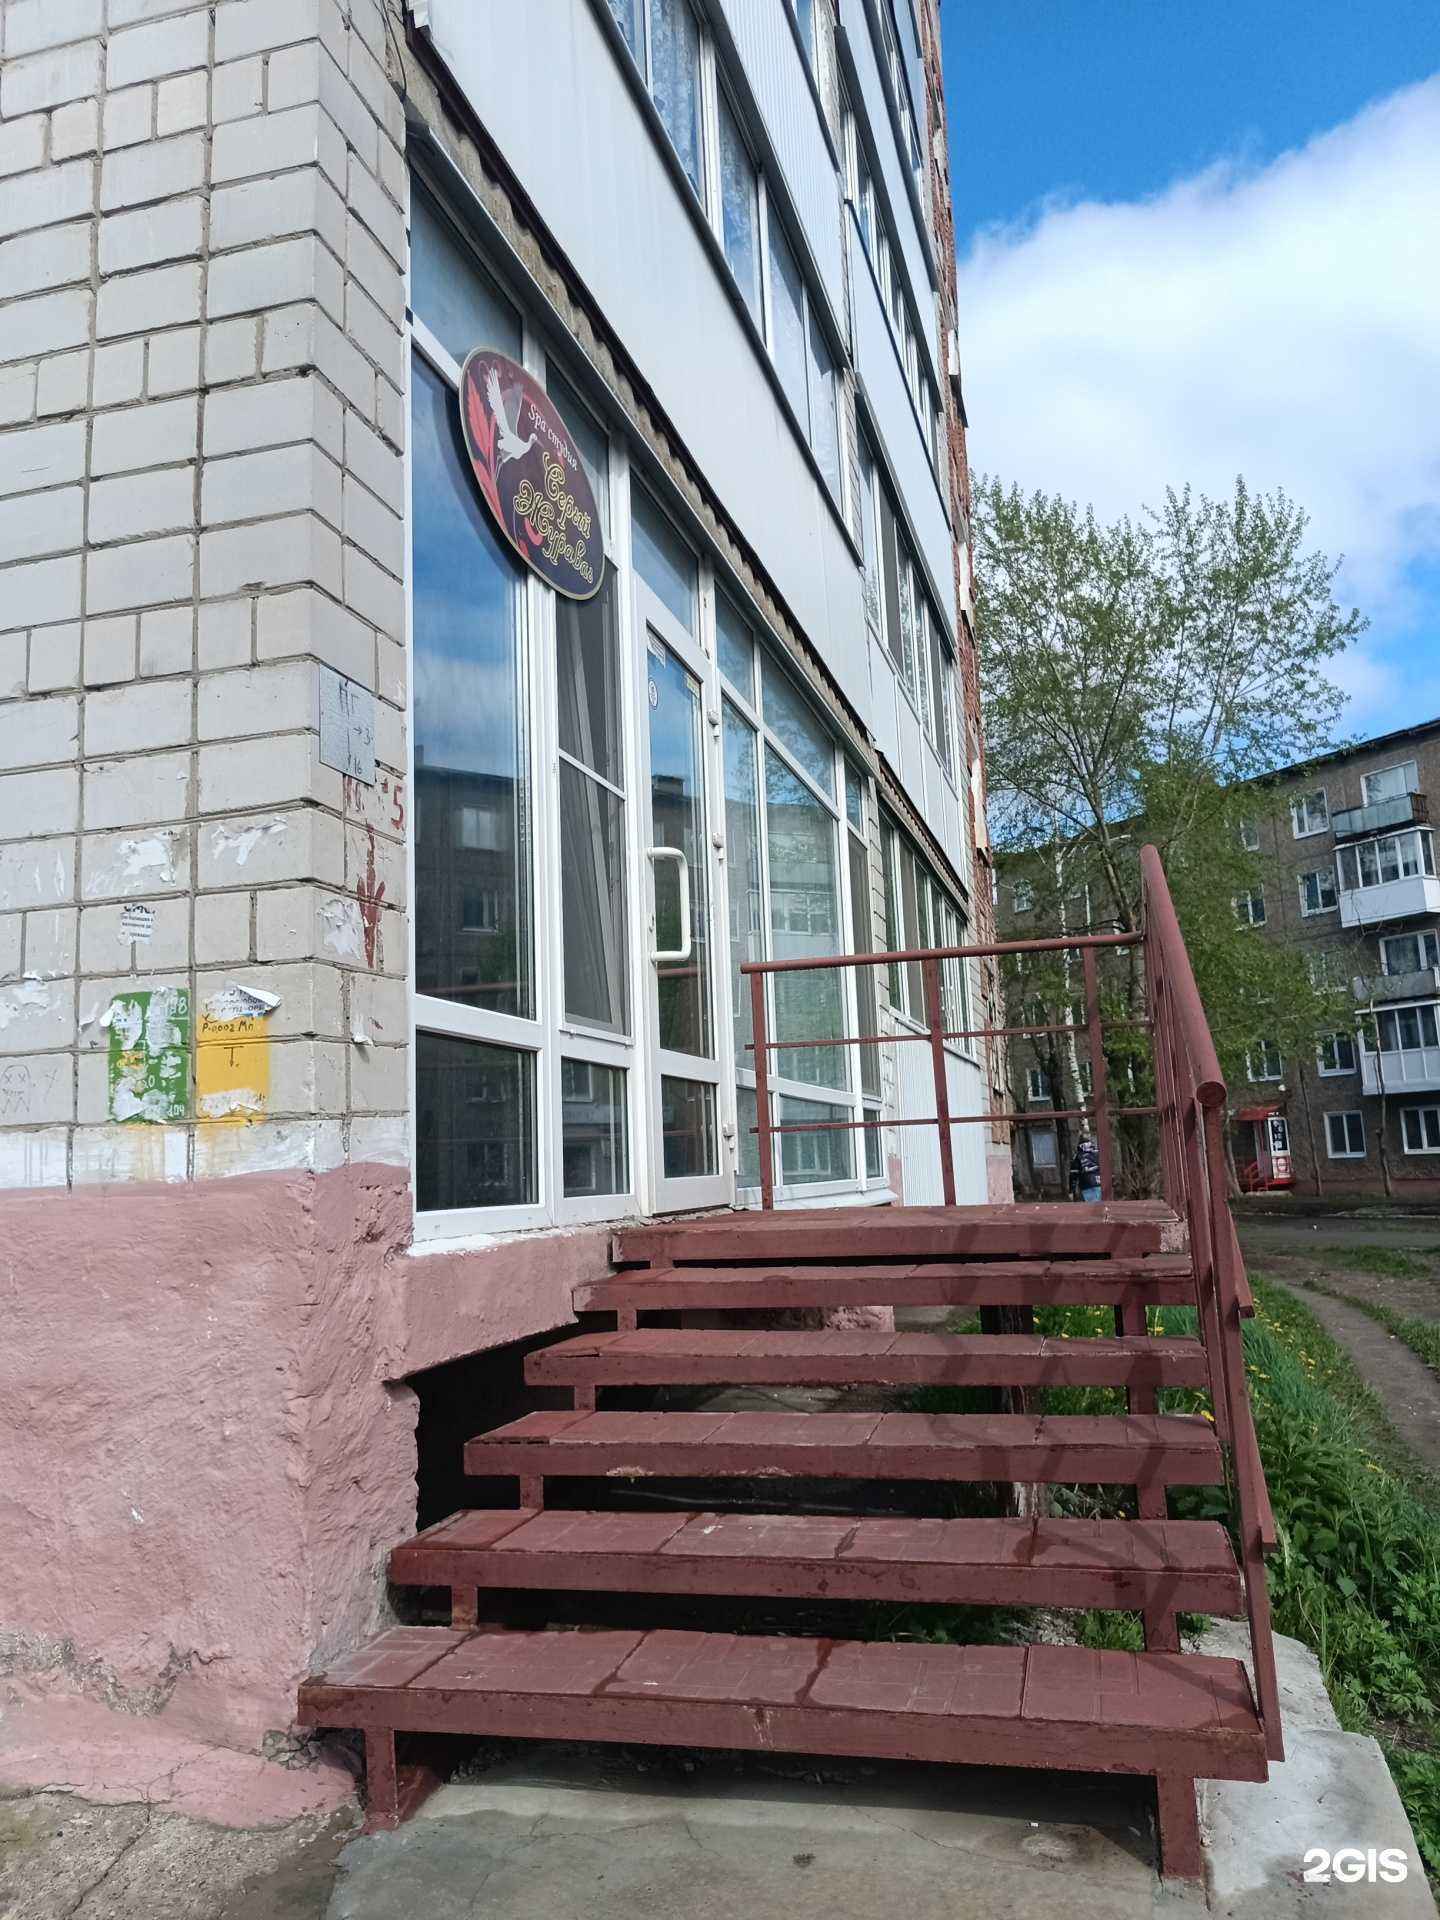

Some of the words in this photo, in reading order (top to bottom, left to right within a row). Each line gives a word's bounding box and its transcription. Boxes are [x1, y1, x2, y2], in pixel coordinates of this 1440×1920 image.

[528, 403, 547, 433] Spa
[547, 428, 578, 471] студия
[542, 451, 591, 539] Серый
